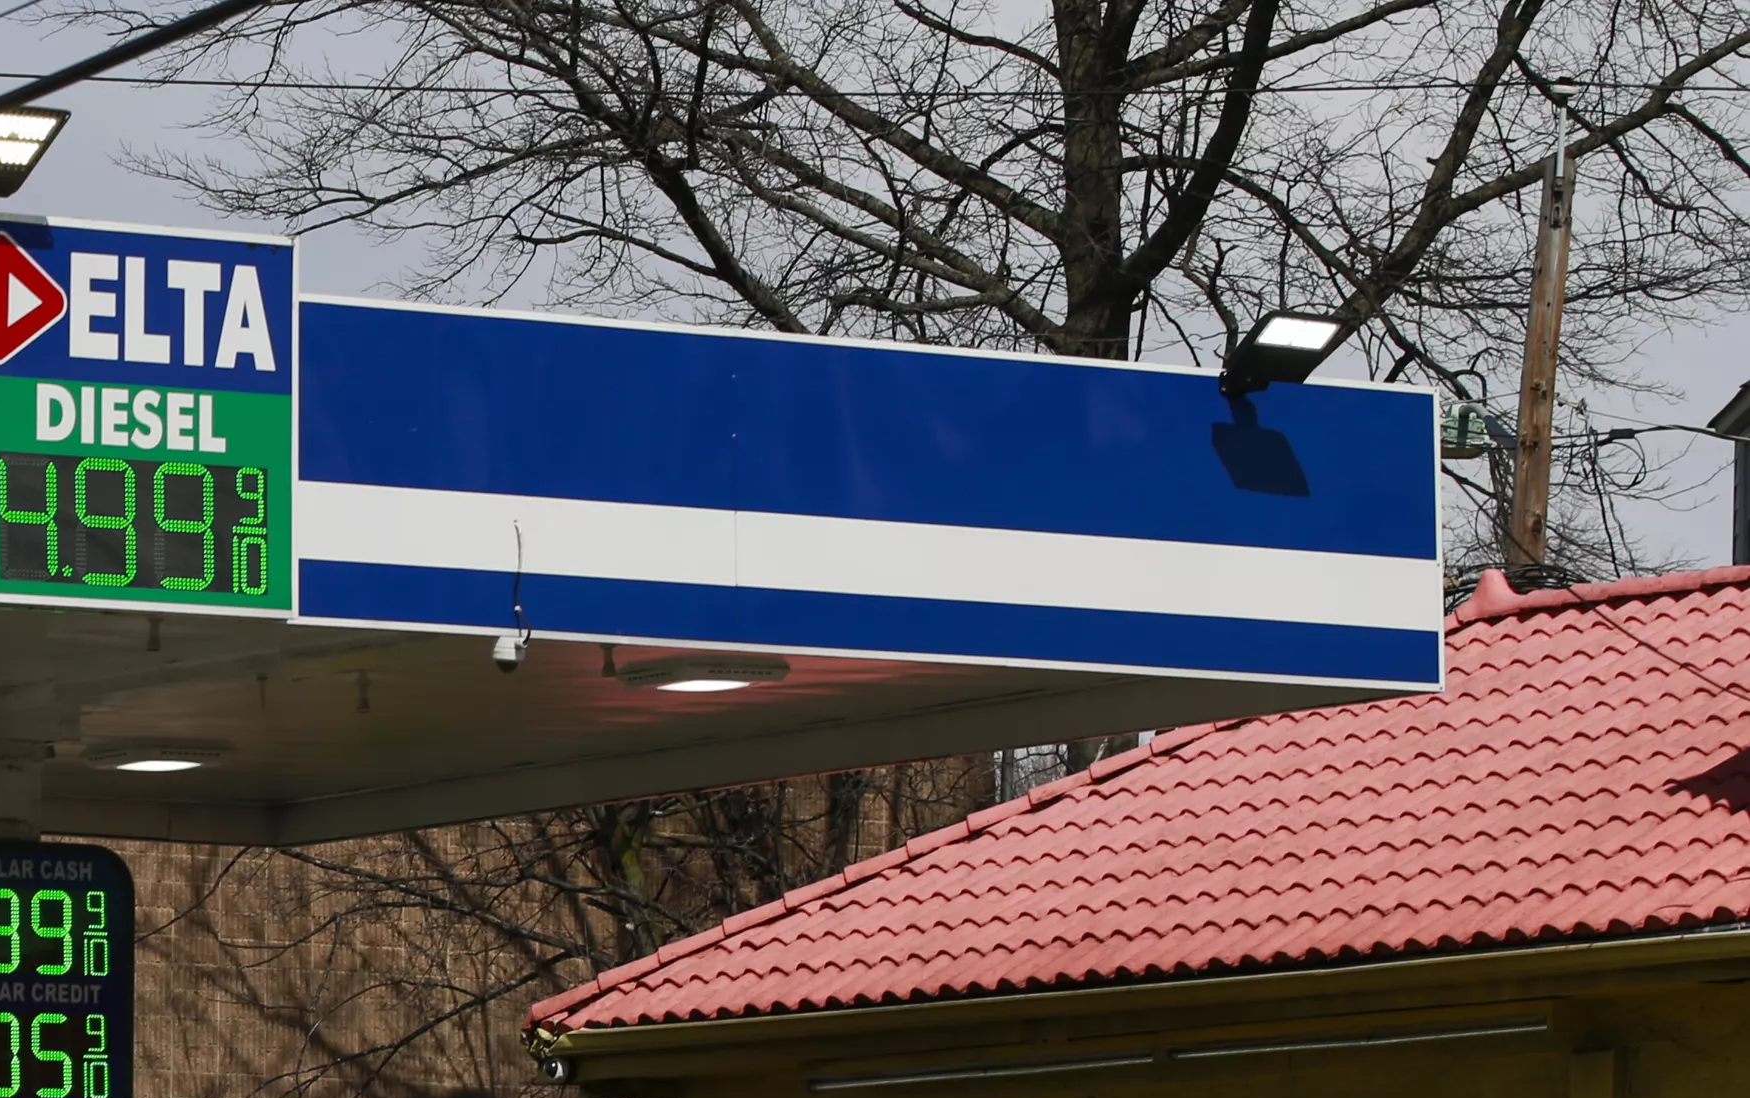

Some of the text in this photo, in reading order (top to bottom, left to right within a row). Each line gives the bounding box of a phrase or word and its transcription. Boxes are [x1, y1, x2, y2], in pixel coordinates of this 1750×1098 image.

[35, 383, 227, 453] DIESEL
[40, 861, 93, 881] CASH
[31, 983, 102, 1004] CREDIT
